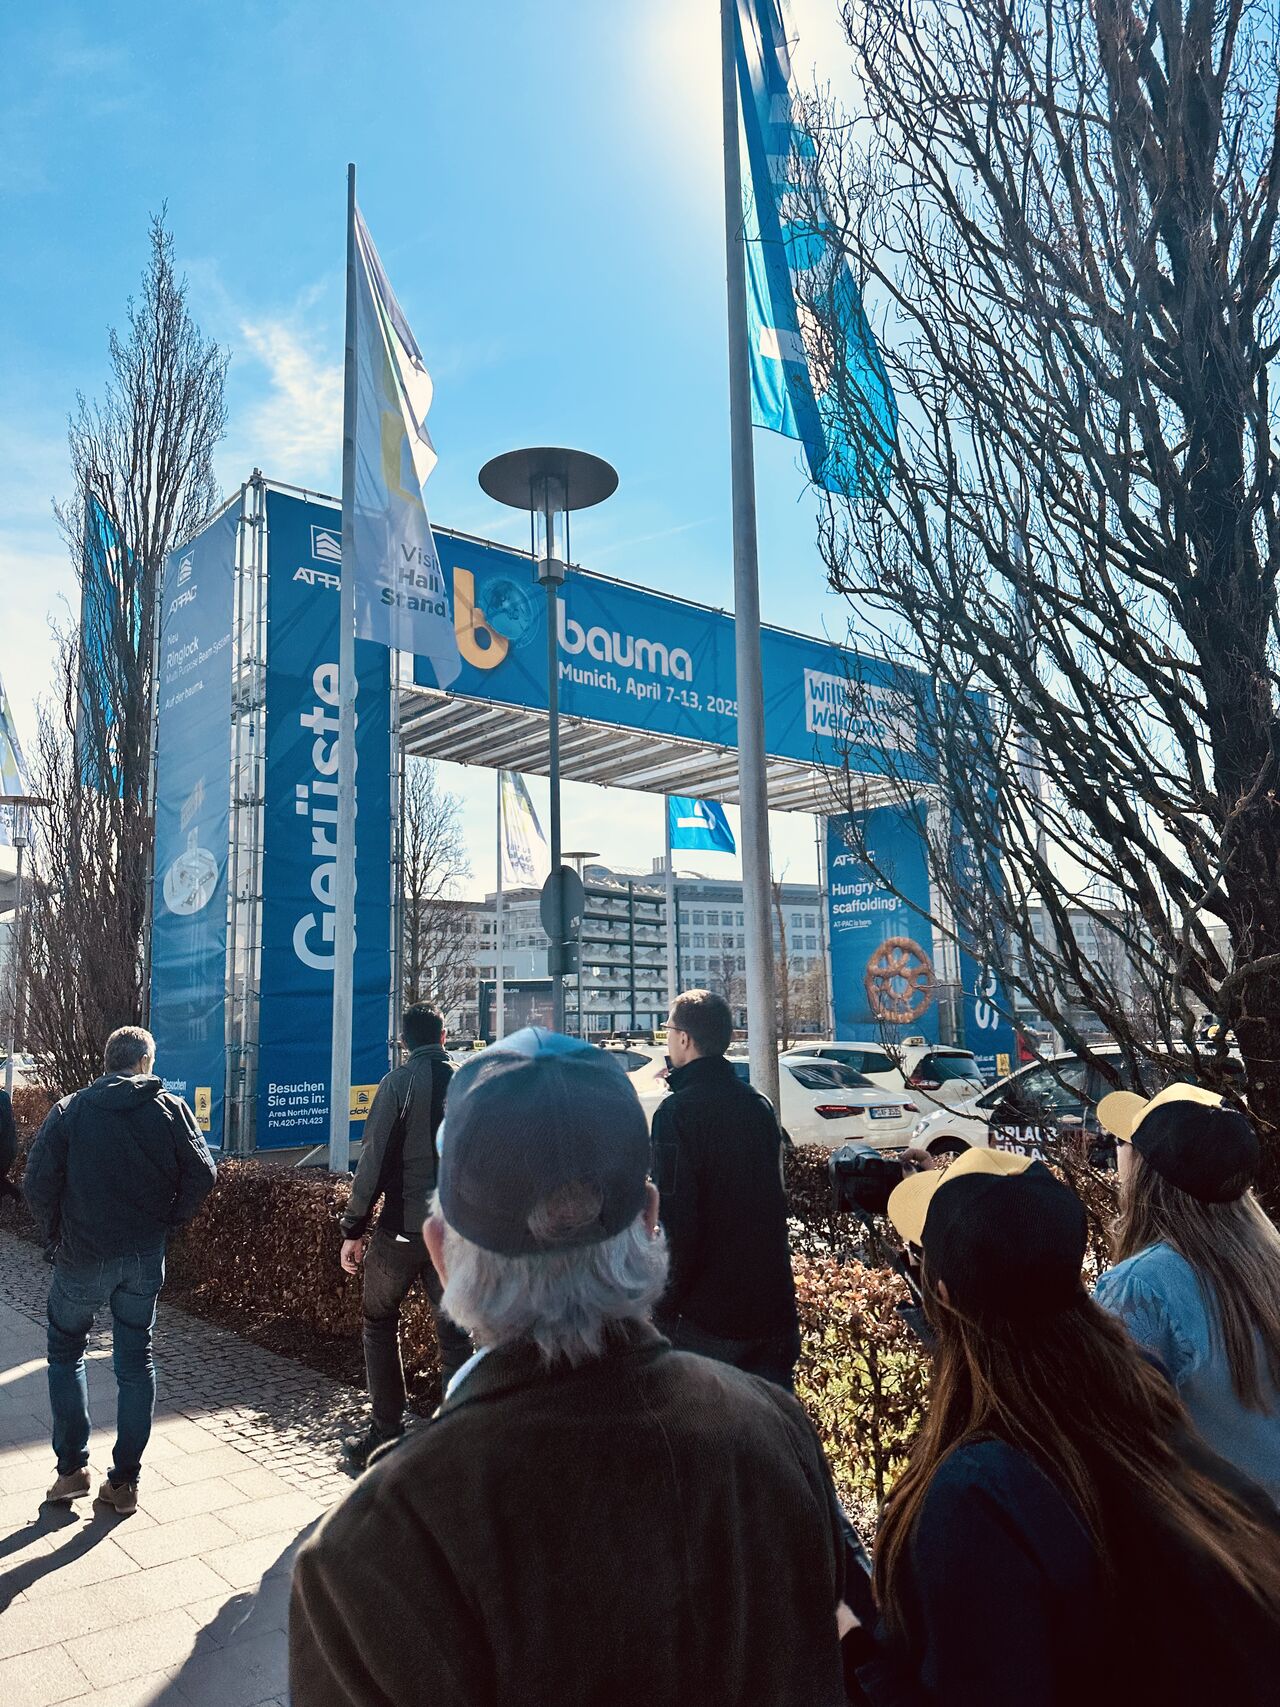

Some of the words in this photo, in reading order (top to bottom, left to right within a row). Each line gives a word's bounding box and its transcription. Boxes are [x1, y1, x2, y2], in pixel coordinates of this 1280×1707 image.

[399, 567, 439, 593] Hall
[380, 587, 446, 618] Stand
[167, 635, 199, 669] Ringlock
[556, 597, 693, 682] bauma
[558, 661, 621, 694] Munich,
[625, 677, 661, 700] April
[666, 686, 703, 711] 7-13,
[292, 662, 359, 971] Gerüste
[832, 881, 874, 896] Hungry
[267, 1095, 287, 1107] Sie
[288, 1095, 309, 1105] uns
[311, 1093, 325, 1103] in:
[268, 1082, 325, 1094] Besuchen
[268, 1110, 287, 1118] Area
[287, 1107, 329, 1117] North/West
[268, 1117, 324, 1128] FN.420-FN.423
